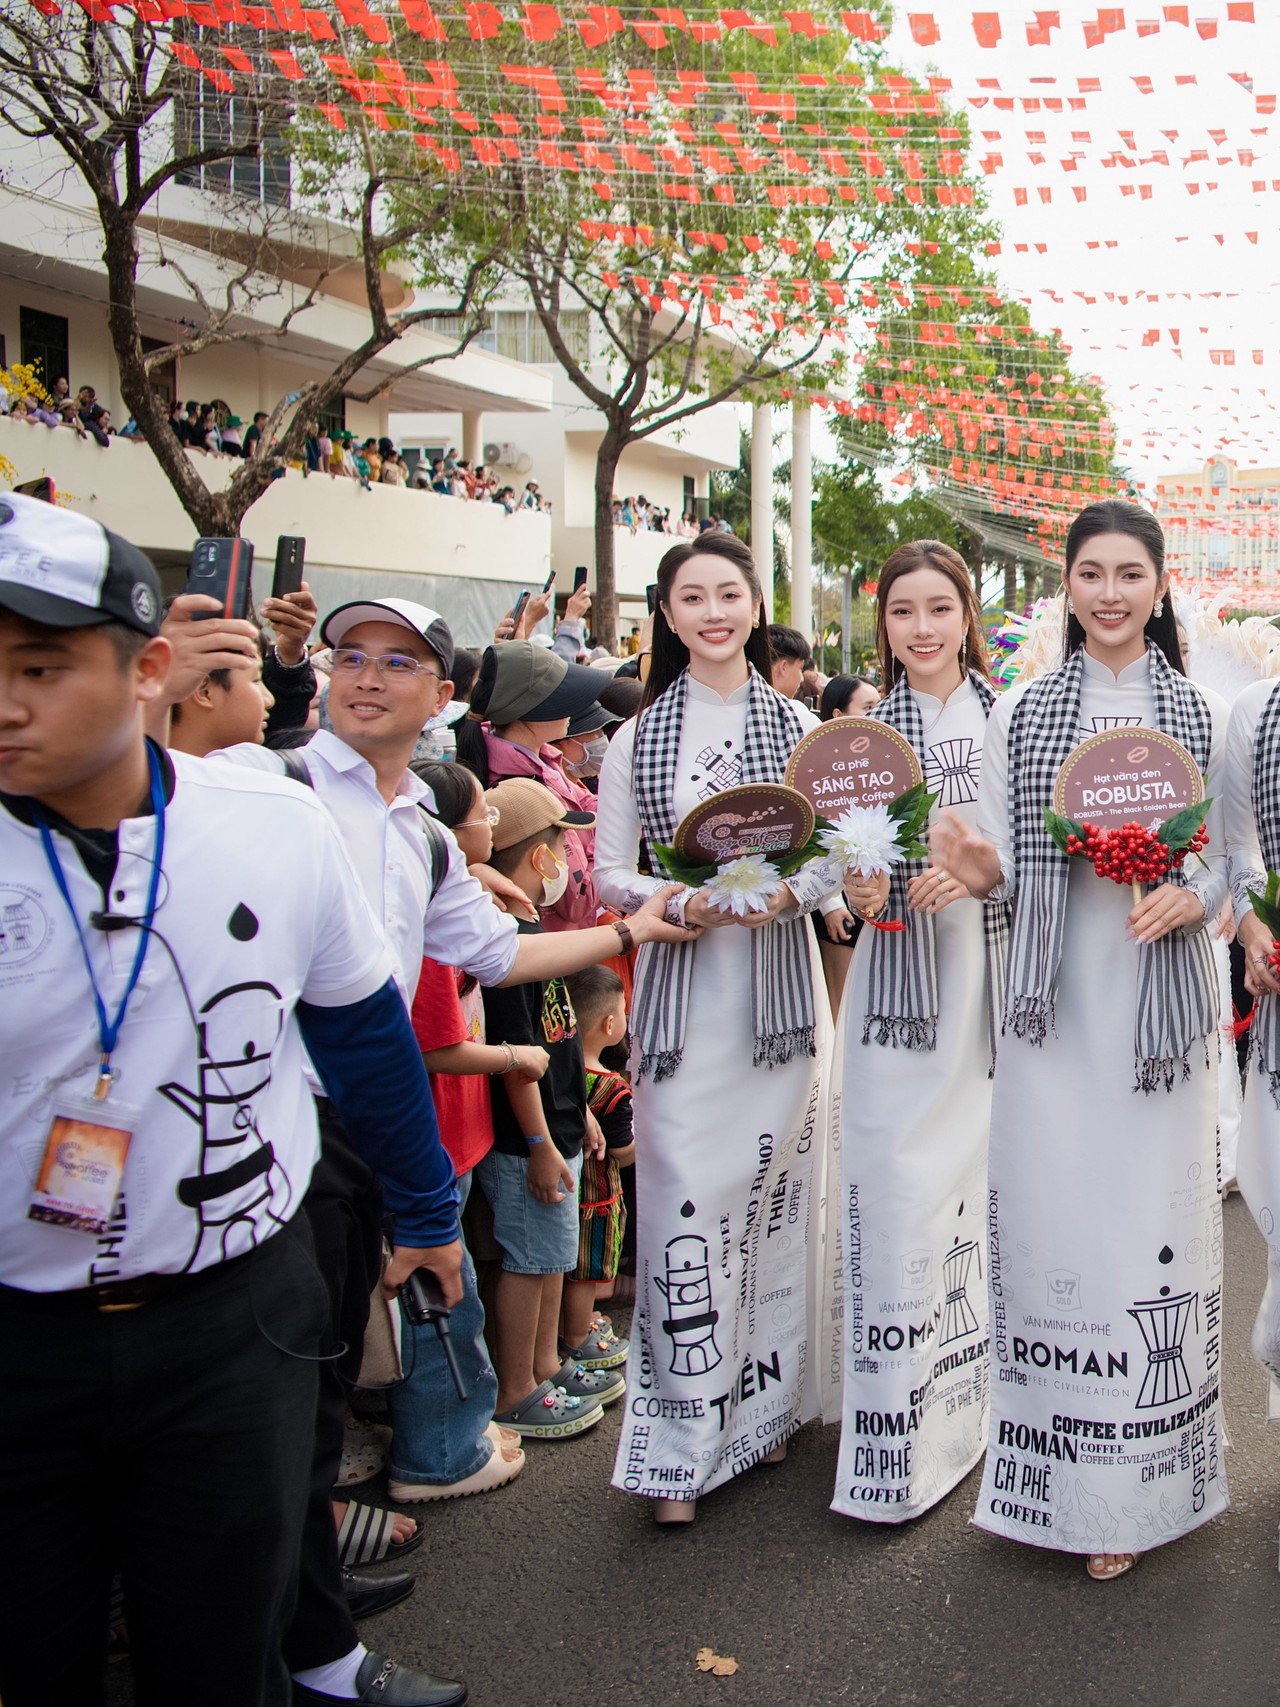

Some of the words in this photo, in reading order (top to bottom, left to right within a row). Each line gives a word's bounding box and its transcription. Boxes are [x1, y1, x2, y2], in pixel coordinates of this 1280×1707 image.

[832, 761, 845, 771] Cà
[848, 758, 869, 771] phê
[1093, 774, 1111, 784] Hạt
[1112, 770, 1139, 782] vàng
[812, 775, 854, 795] SÁNG
[858, 770, 894, 791] TẠO
[1082, 781, 1176, 807] ROBUSTA
[816, 795, 860, 809] Creative
[861, 790, 895, 802] Coffee
[1073, 809, 1103, 819] ROBUSTA
[1109, 807, 1122, 815] The
[1123, 805, 1142, 814] Black
[1143, 803, 1168, 812] Golden
[1169, 801, 1187, 809] Bean
[762, 841, 790, 851] 2025
[758, 1133, 774, 1197] COFFEE
[788, 1179, 802, 1224] COFFEE
[720, 1212, 731, 1279] COFFEE
[848, 1183, 862, 1288] CIVILIZATION
[988, 1189, 1003, 1297] CIVILIZATION
[1210, 1200, 1222, 1282] Legend
[739, 1200, 760, 1309] CIVILIZATION
[759, 1286, 792, 1305] COFFEE
[897, 1299, 925, 1313] MINH
[1056, 1296, 1072, 1306] GOLD
[1203, 1283, 1222, 1332] PHÊ
[852, 1292, 864, 1354] COFFEE
[868, 1302, 942, 1352] ROMAN
[995, 1301, 1008, 1363] COFFEE
[1022, 1315, 1042, 1329] VĂN
[1043, 1317, 1072, 1332] MINH
[1073, 1319, 1088, 1334] CÀ
[1090, 1323, 1112, 1337] PHÊ
[586, 1353, 624, 1370] crocs
[854, 1356, 879, 1374] coffee
[1012, 1336, 1129, 1378] ROMAN
[1203, 1333, 1221, 1371] CÀ
[972, 1365, 982, 1402] coffee
[999, 1366, 1028, 1387] coffee
[1054, 1379, 1131, 1398] CIVILIZATION
[1198, 1370, 1220, 1398] coffee
[632, 1396, 705, 1419] COFFEE
[945, 1395, 956, 1416] CÀ
[958, 1387, 972, 1410] PHÊ
[1052, 1414, 1117, 1440] COFFEE
[1122, 1387, 1220, 1440] CIVILIZATION
[534, 1421, 584, 1437] crocs
[756, 1407, 793, 1439] COFFEE
[998, 1419, 1079, 1464] ROMAN
[1080, 1441, 1125, 1455] COFFEE
[1080, 1453, 1115, 1466] COFFEE
[1117, 1444, 1177, 1466] CIVILIZATION
[1181, 1429, 1191, 1471] coffee
[1208, 1410, 1218, 1484] ROMAN
[854, 1441, 875, 1478] CÀ
[880, 1441, 912, 1480] PHÊ
[1141, 1462, 1155, 1483] CÀ
[1157, 1455, 1177, 1476] PHÊ
[1192, 1416, 1206, 1514] COFFEE
[850, 1484, 913, 1504] COFFEE
[994, 1455, 1016, 1493] CÀ
[1021, 1463, 1052, 1503] PHÊ
[990, 1498, 1053, 1529] COFFEE
